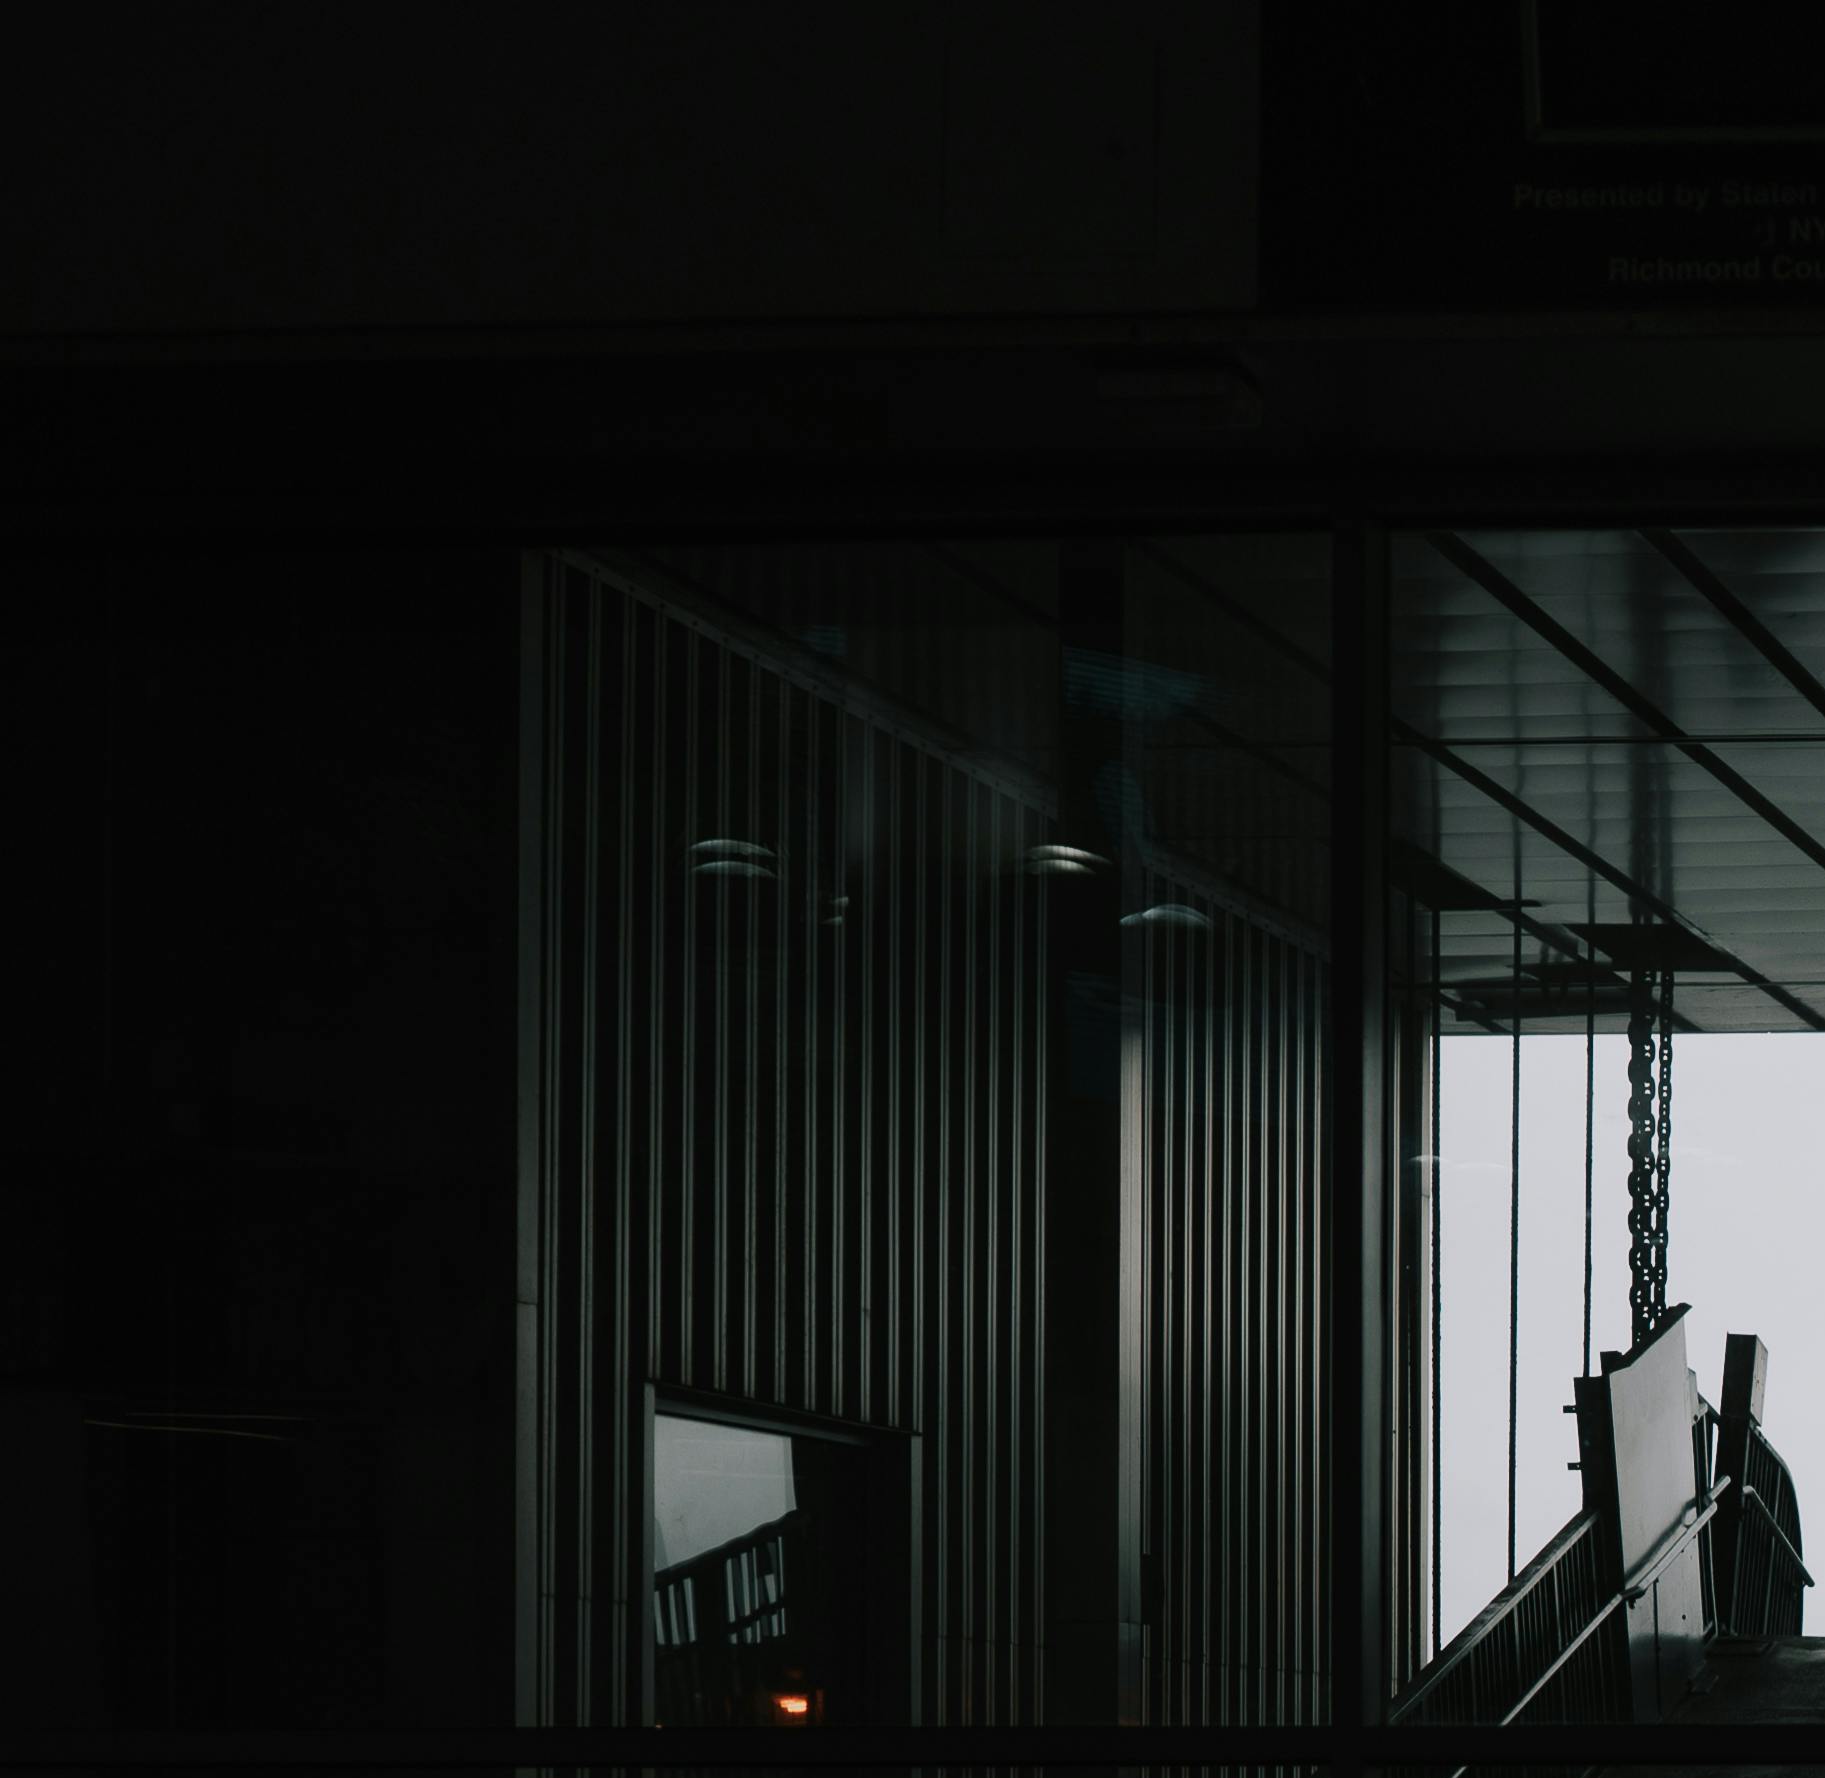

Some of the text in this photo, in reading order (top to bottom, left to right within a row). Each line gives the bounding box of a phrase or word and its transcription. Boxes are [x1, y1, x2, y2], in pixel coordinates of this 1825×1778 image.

[1513, 181, 1664, 208] Presented
[1675, 180, 1711, 213] by
[1721, 178, 1818, 206] Staten
[1608, 255, 1761, 281] Richmond
